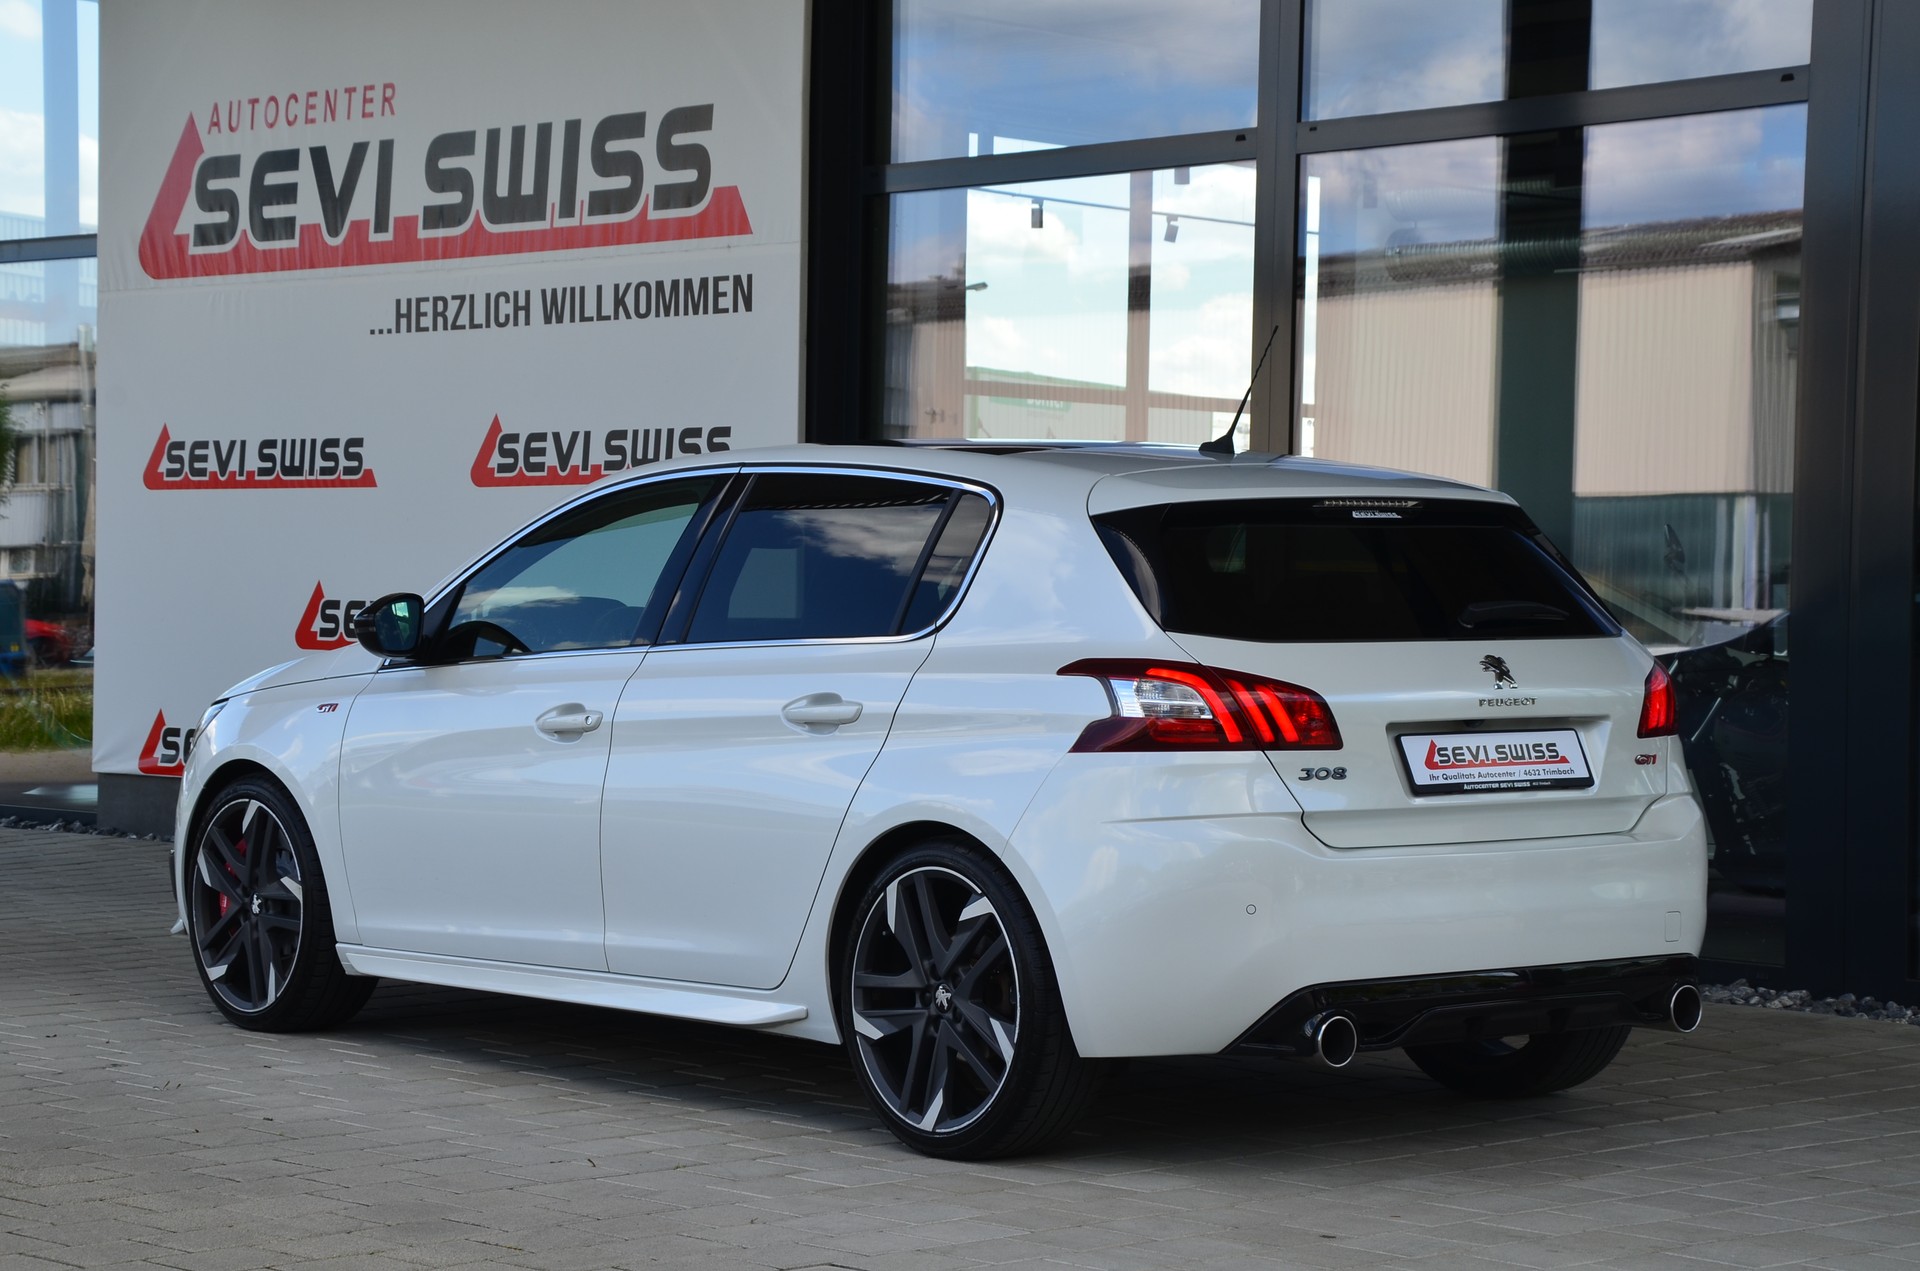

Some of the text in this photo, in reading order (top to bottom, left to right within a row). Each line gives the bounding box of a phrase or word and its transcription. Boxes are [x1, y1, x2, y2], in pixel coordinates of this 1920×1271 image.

[208, 82, 397, 134] AUTOCENTER
[192, 103, 715, 249] SEVI SWISS
[540, 273, 754, 325] WILLKOMMEN
[164, 437, 365, 479] SEVI SWISS
[495, 426, 732, 474] SEVI SWISS
[1478, 696, 1538, 707] PEUGEOT
[1297, 766, 1348, 781] 308
[1429, 773, 1440, 782] Ihr
[1477, 770, 1516, 779] Autocenter
[1523, 768, 1541, 777] 4632
[1542, 767, 1575, 776] Trimbach
[1435, 742, 1560, 765] SEVI SWISS
